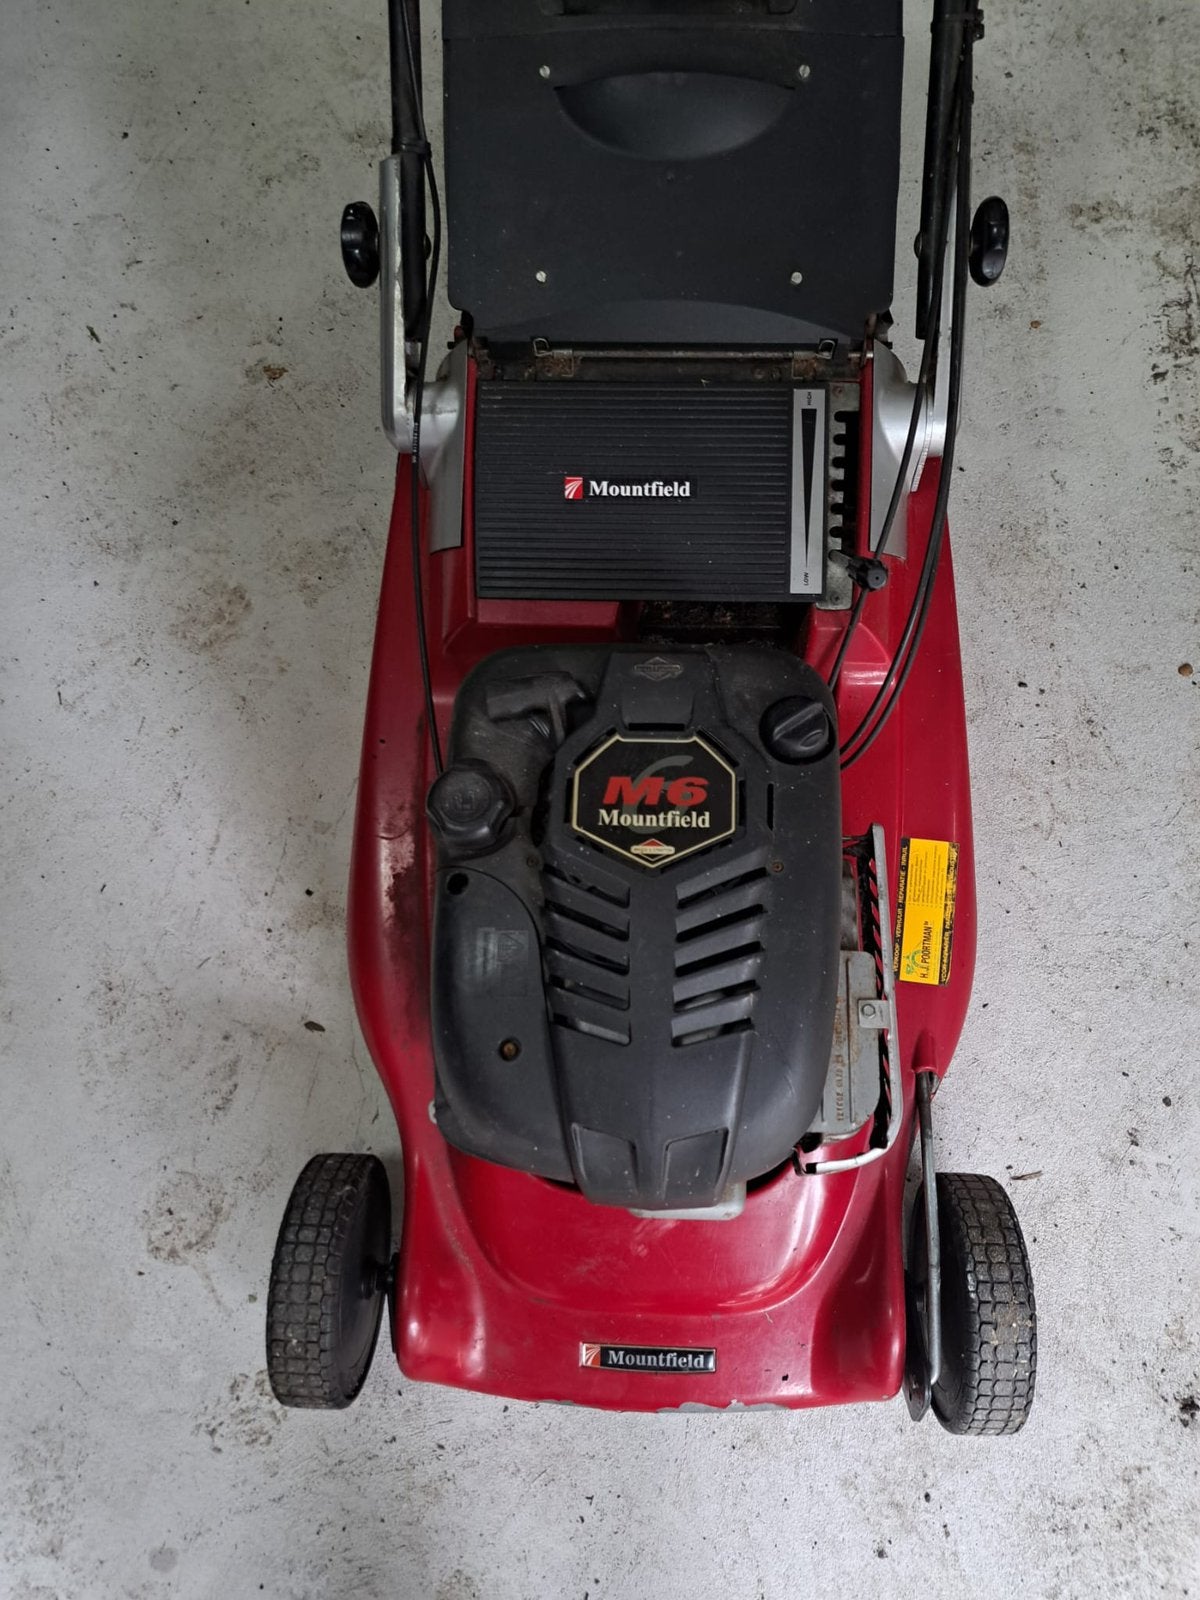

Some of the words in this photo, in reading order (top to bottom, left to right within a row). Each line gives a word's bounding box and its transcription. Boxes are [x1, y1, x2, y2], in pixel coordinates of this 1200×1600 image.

[589, 480, 690, 497] Mountfield
[603, 776, 710, 806] M6
[598, 808, 711, 828] Mountfield
[898, 870, 907, 903] REPARATIE
[920, 926, 932, 964] POORTMAN
[608, 1350, 704, 1368] Mountfield
